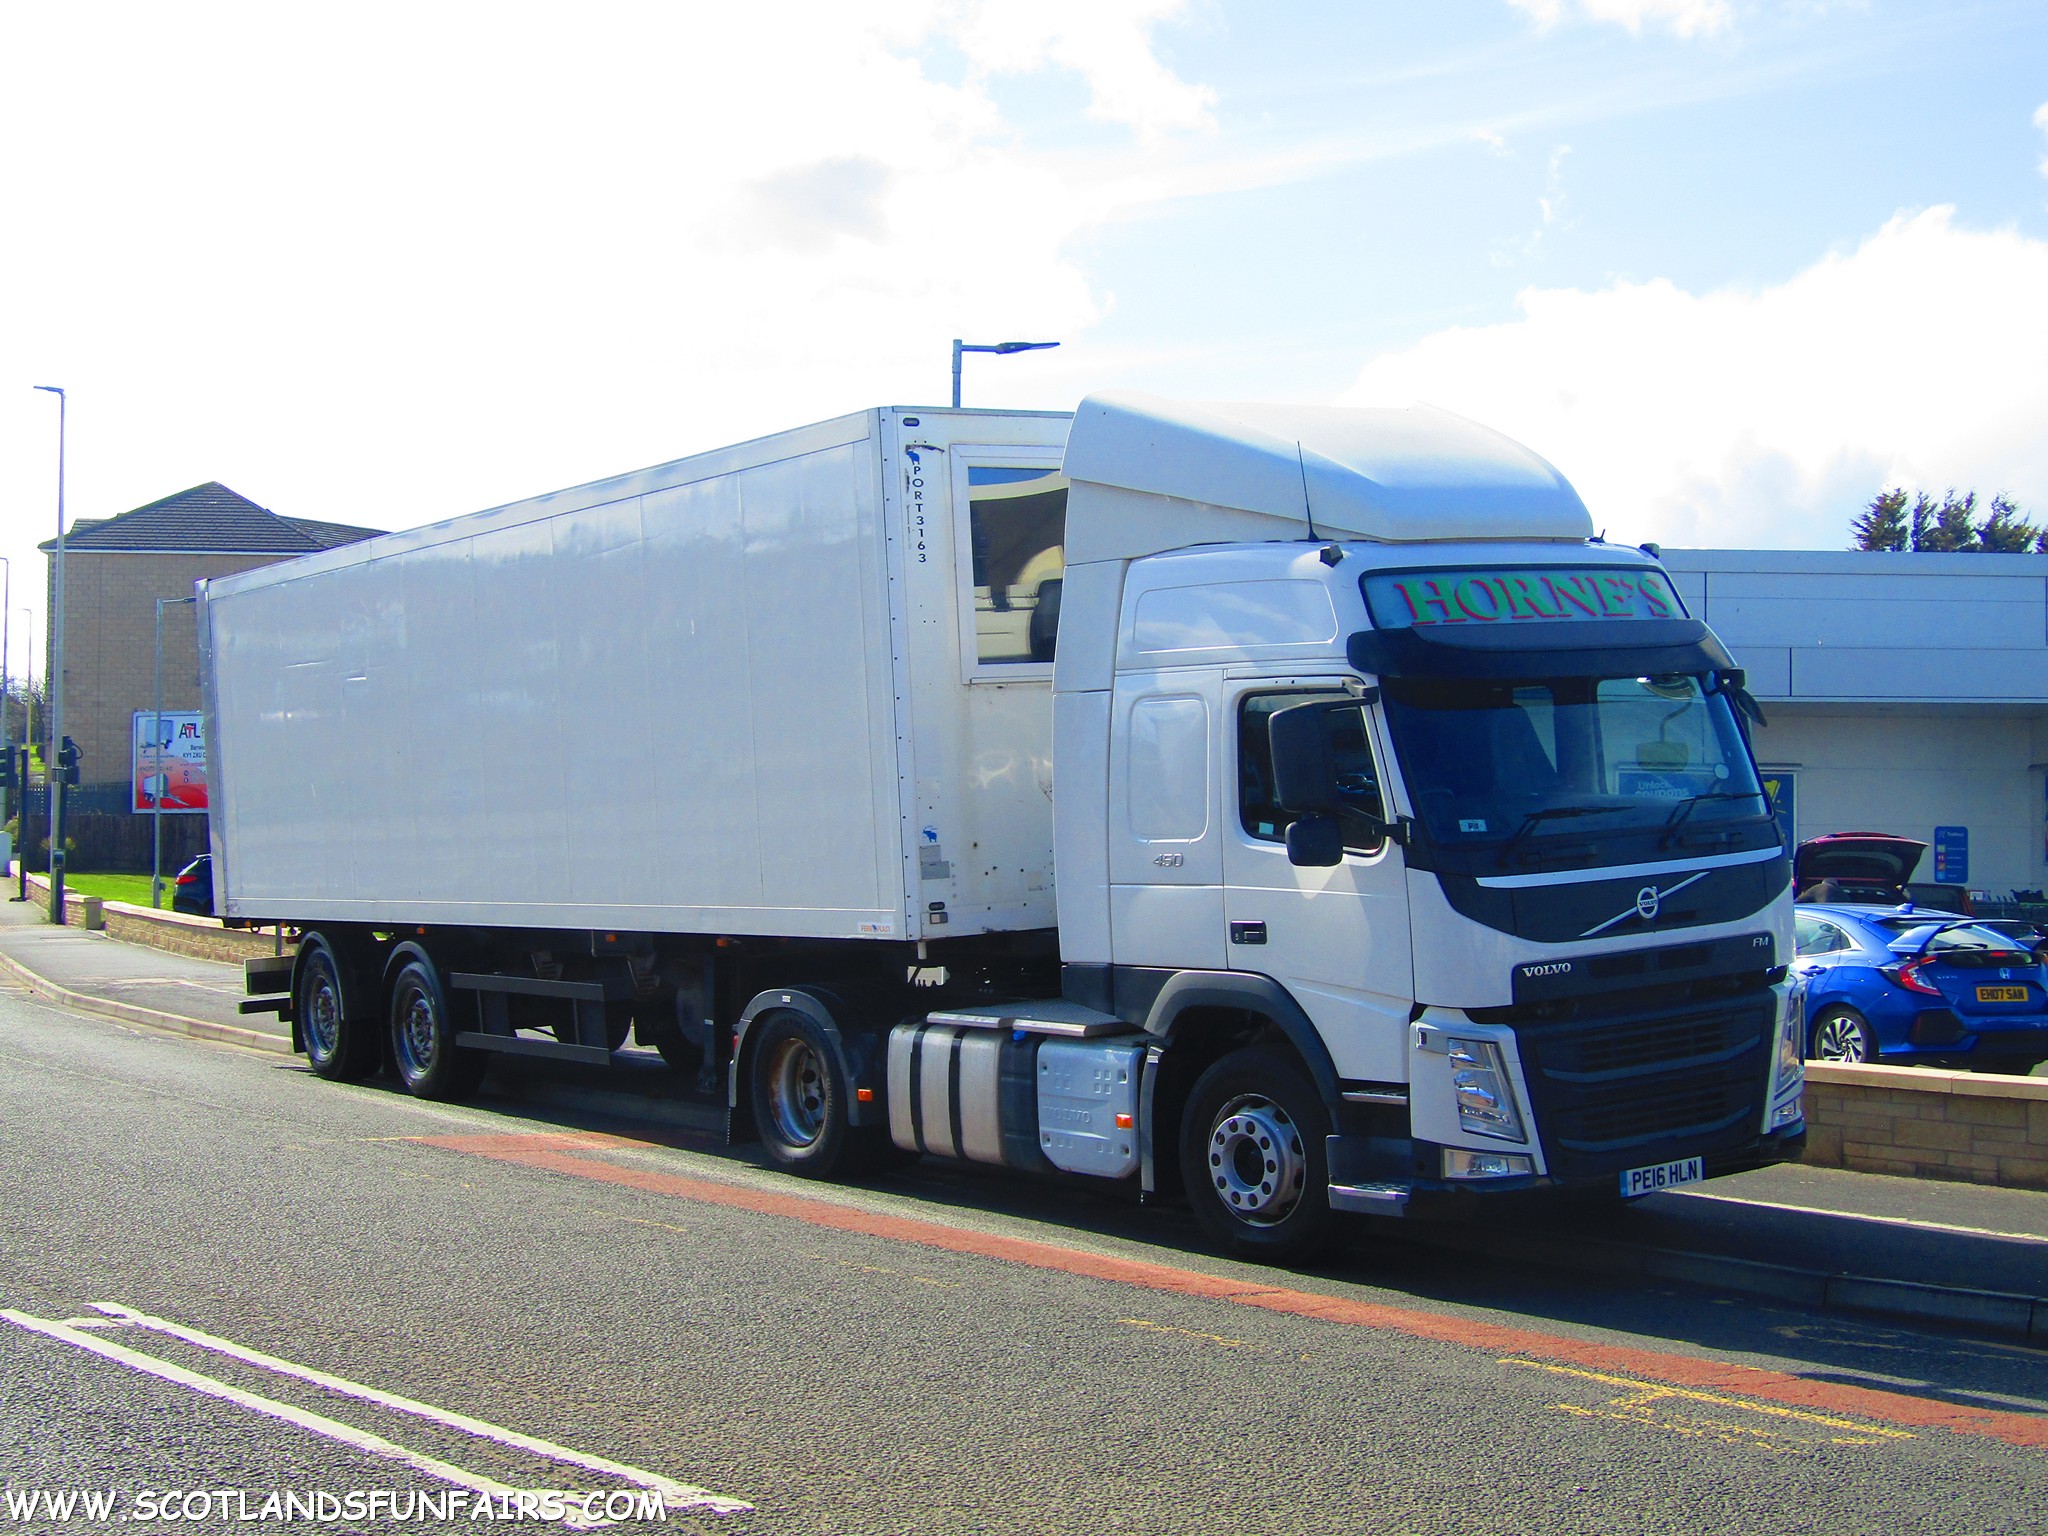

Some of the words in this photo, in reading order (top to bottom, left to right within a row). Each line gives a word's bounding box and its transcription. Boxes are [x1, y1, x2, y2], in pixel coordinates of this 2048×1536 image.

[1393, 573, 1675, 626] HORNE'S
[1153, 853, 1184, 867] 450
[1752, 936, 1770, 948] FM
[1522, 962, 1572, 977] VOLVO
[1632, 1166, 1666, 1191] PE16
[1669, 1160, 1698, 1184] HLN
